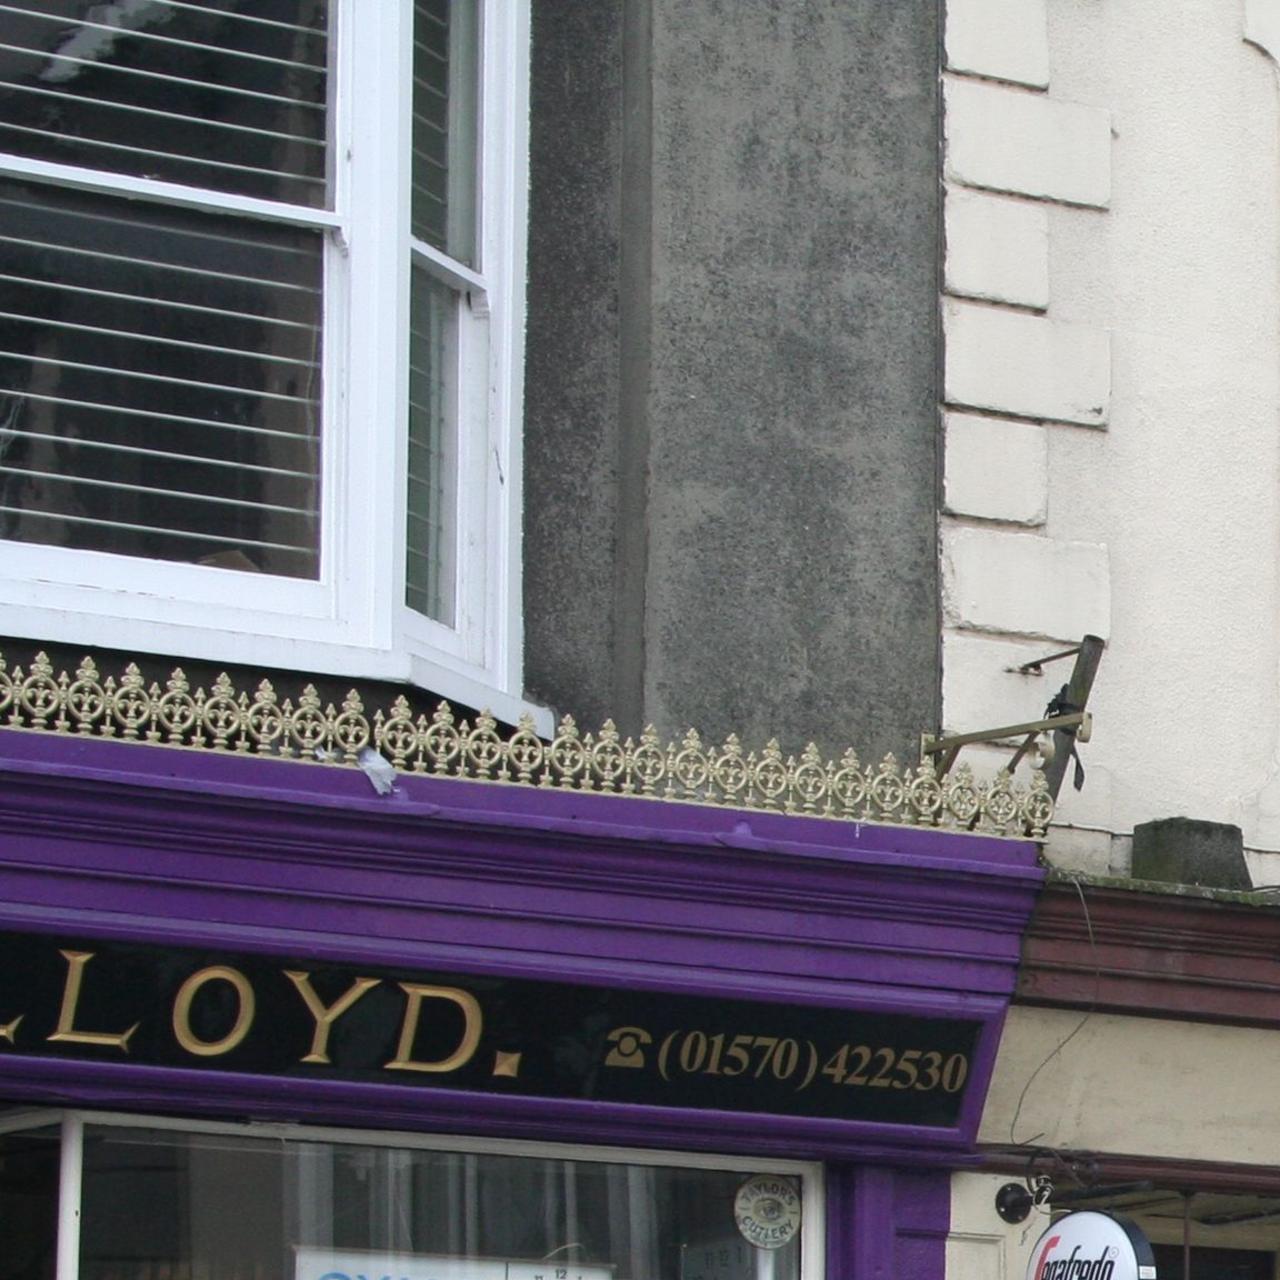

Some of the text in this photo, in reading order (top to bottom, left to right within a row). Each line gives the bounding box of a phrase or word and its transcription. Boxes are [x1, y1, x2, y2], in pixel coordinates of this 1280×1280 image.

[0, 948, 521, 1079] LOYD.
[741, 1214, 796, 1241] CUTLERY
[555, 1268, 567, 1280] 12
